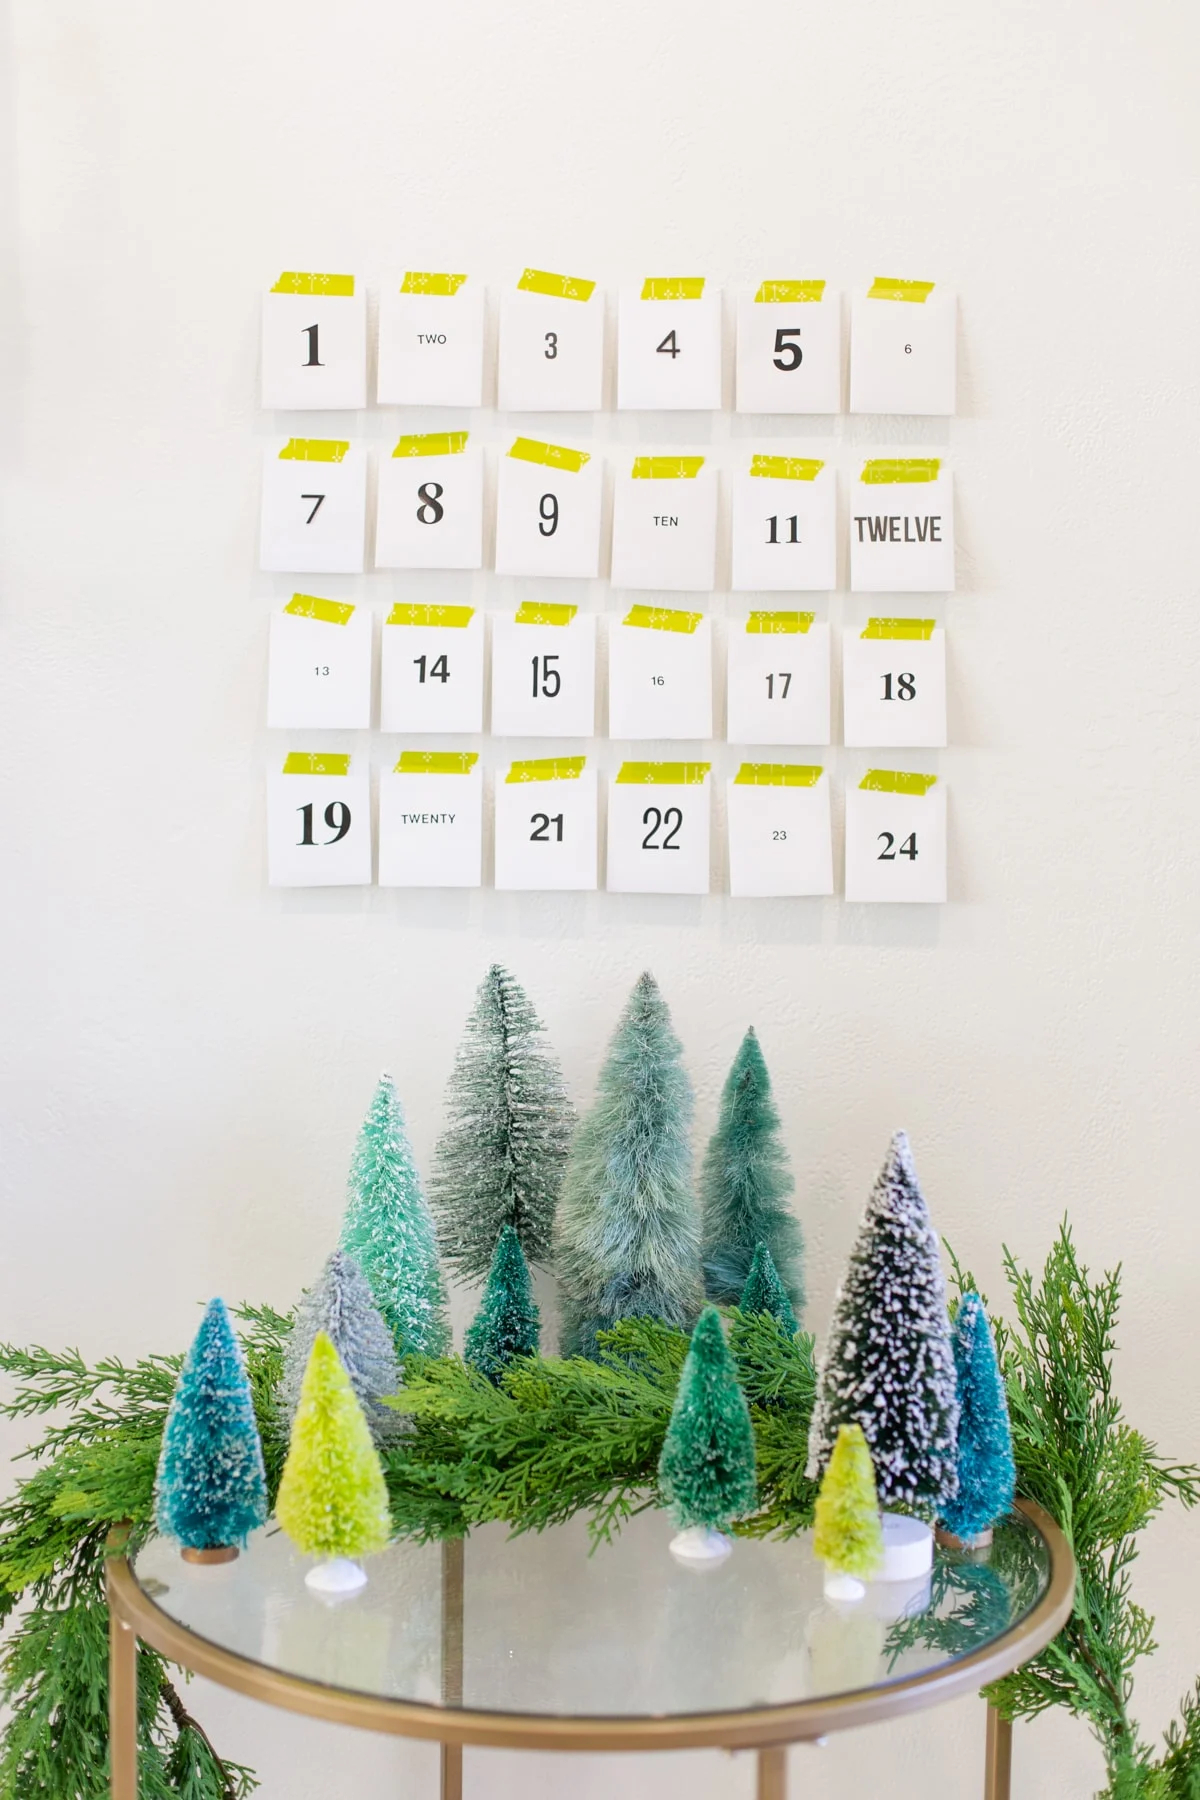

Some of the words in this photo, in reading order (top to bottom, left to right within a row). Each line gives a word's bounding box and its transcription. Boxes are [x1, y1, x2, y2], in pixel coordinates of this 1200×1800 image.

[301, 323, 325, 367] 1
[417, 334, 447, 345] TWO
[544, 332, 558, 360] 3
[655, 329, 681, 359] 4
[772, 328, 803, 372] 5
[904, 343, 912, 354] 6
[300, 494, 326, 525] 7
[416, 482, 444, 525] 8
[538, 493, 559, 537] 9
[653, 516, 679, 527] TEN
[765, 515, 802, 544] 11
[855, 515, 942, 543] TWELVE
[315, 666, 330, 676] 13
[413, 654, 451, 684] 14
[531, 655, 561, 698] 15
[651, 676, 665, 686] 16
[765, 672, 792, 700] 17
[880, 672, 917, 701] 18
[296, 801, 352, 846] 19
[401, 813, 456, 824] TWENTY
[529, 812, 564, 842] 21
[641, 806, 683, 850] 22
[772, 830, 787, 841] 23
[877, 831, 919, 861] 24
